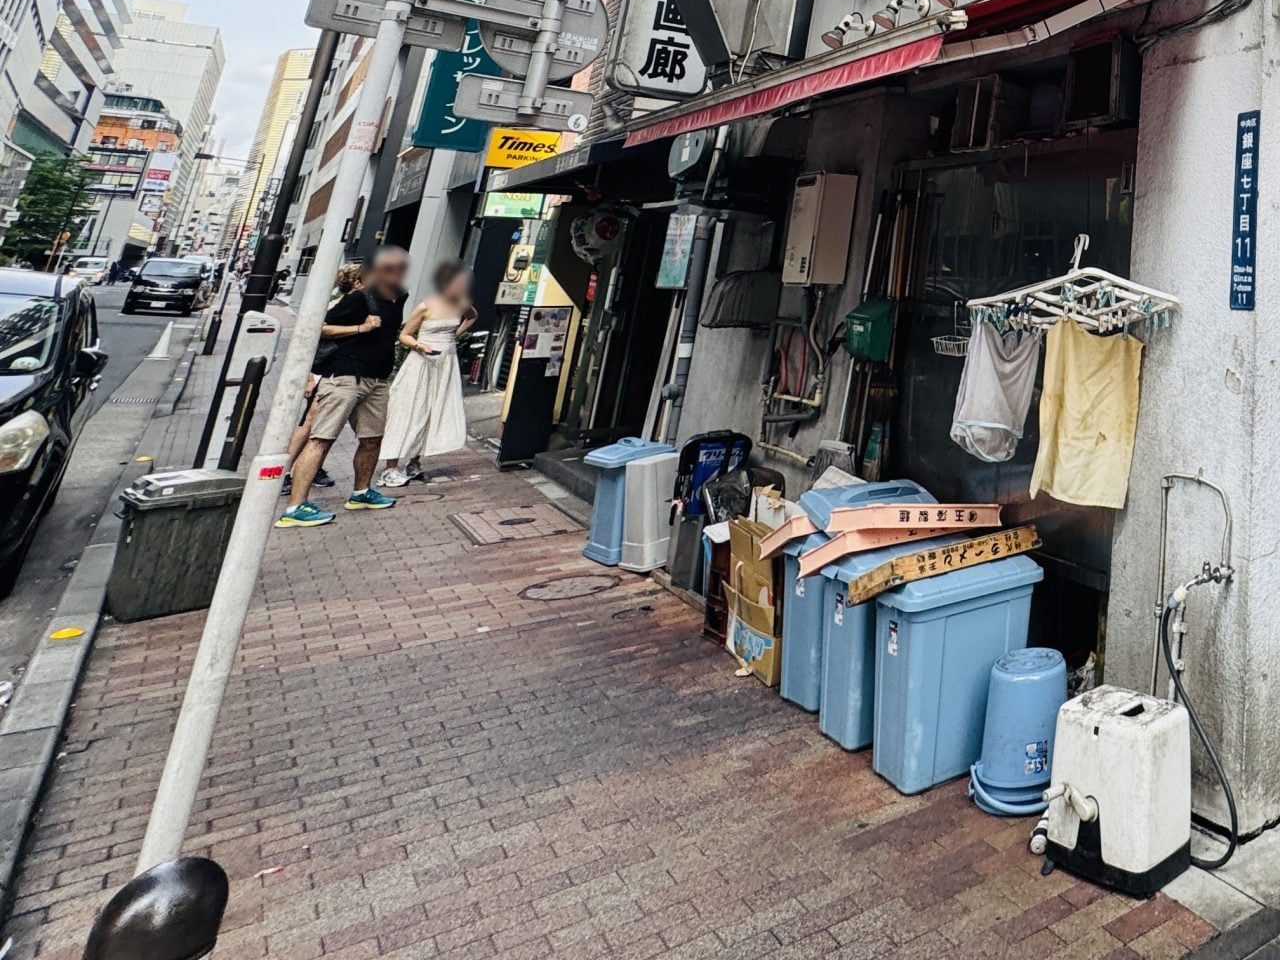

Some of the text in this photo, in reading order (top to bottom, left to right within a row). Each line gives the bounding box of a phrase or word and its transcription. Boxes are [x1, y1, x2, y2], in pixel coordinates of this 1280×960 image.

[1240, 118, 1257, 128] 中央区
[498, 135, 558, 153] Times
[1233, 274, 1252, 283] Ginza
[1237, 292, 1247, 305] 11
